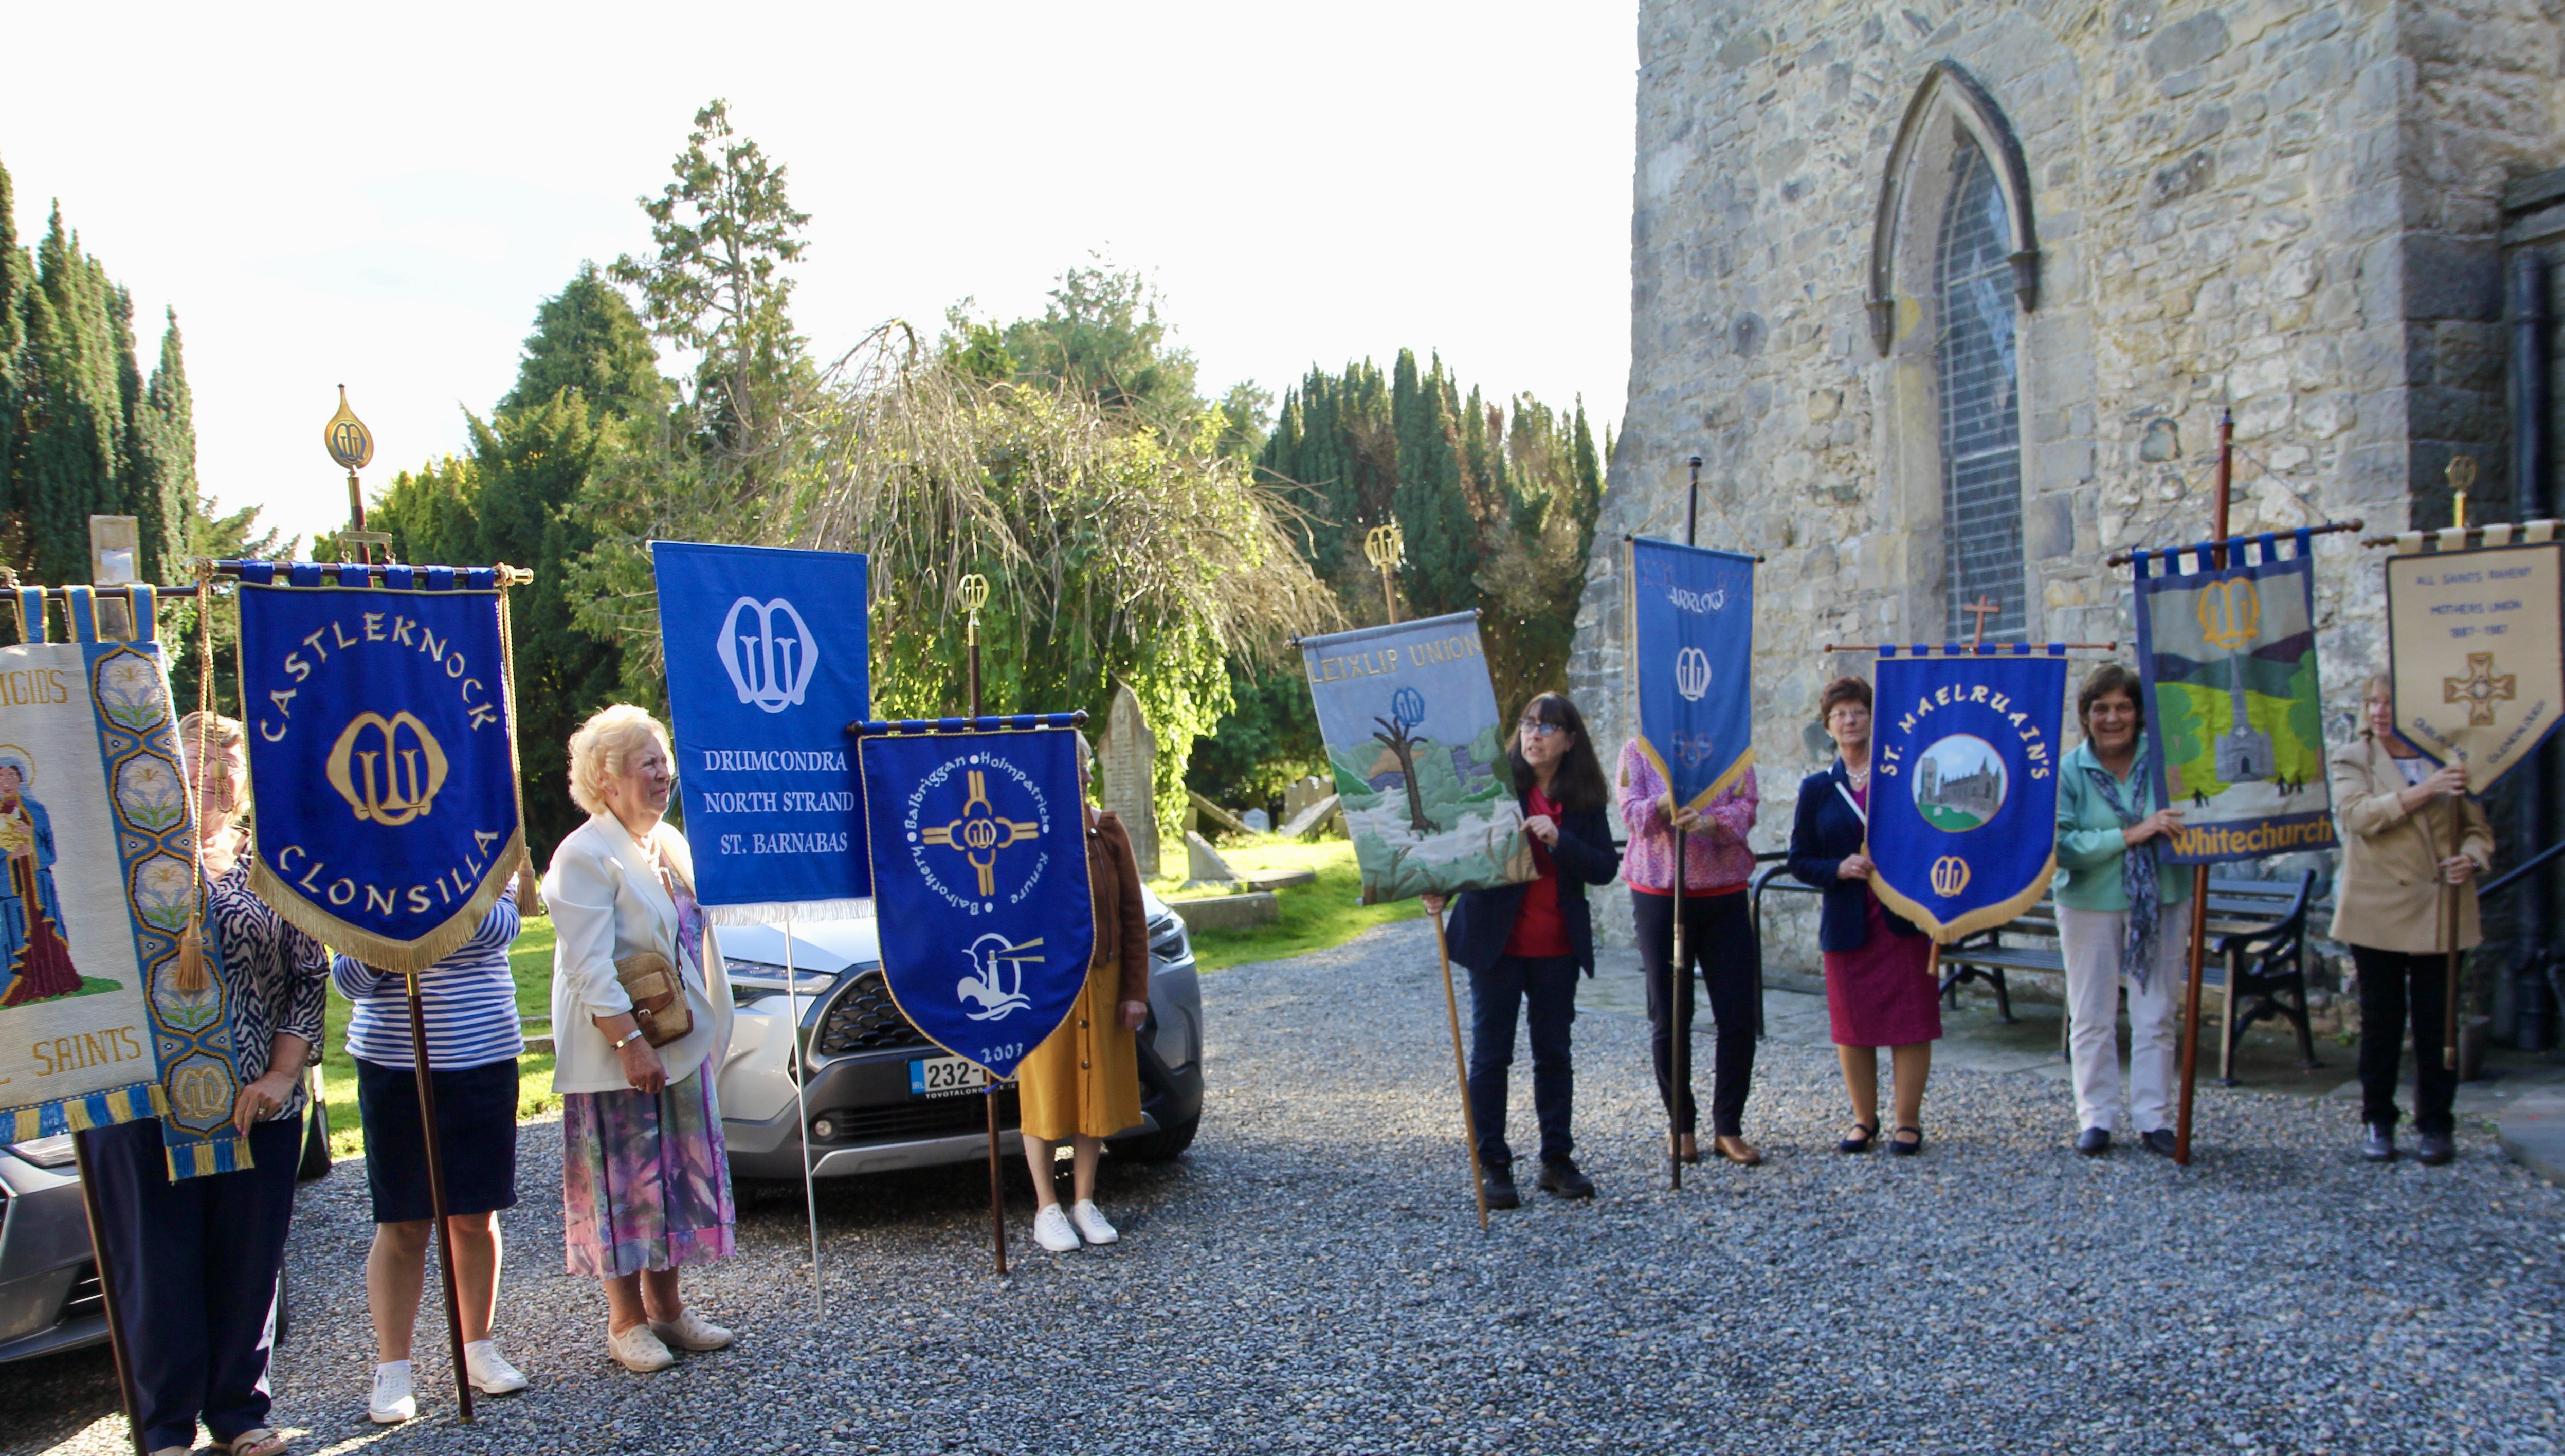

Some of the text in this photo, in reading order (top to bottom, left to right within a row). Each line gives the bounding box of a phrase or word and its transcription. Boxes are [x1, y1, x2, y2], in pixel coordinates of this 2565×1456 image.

[2443, 570, 2483, 585] SAINTS
[260, 612, 497, 742] CASTLEKNOCK
[1307, 631, 1483, 684] LEIXLIP UNION
[1898, 683, 2049, 780] MAELRUAIN'S
[703, 750, 848, 771] DRUMCONDRA
[704, 791, 854, 813] NORTH STRAND
[904, 756, 966, 830] Balbriggan
[980, 751, 1050, 827] Holmpatrick
[721, 832, 848, 854] ST. BARNABAS
[2171, 815, 2333, 857] Whitechurch
[279, 829, 499, 916] CLONSILLA
[911, 846, 979, 915] Balrothery
[31, 1026, 141, 1077] SAINTS
[981, 1043, 1023, 1063] 2003
[912, 1081, 925, 1090] IRL
